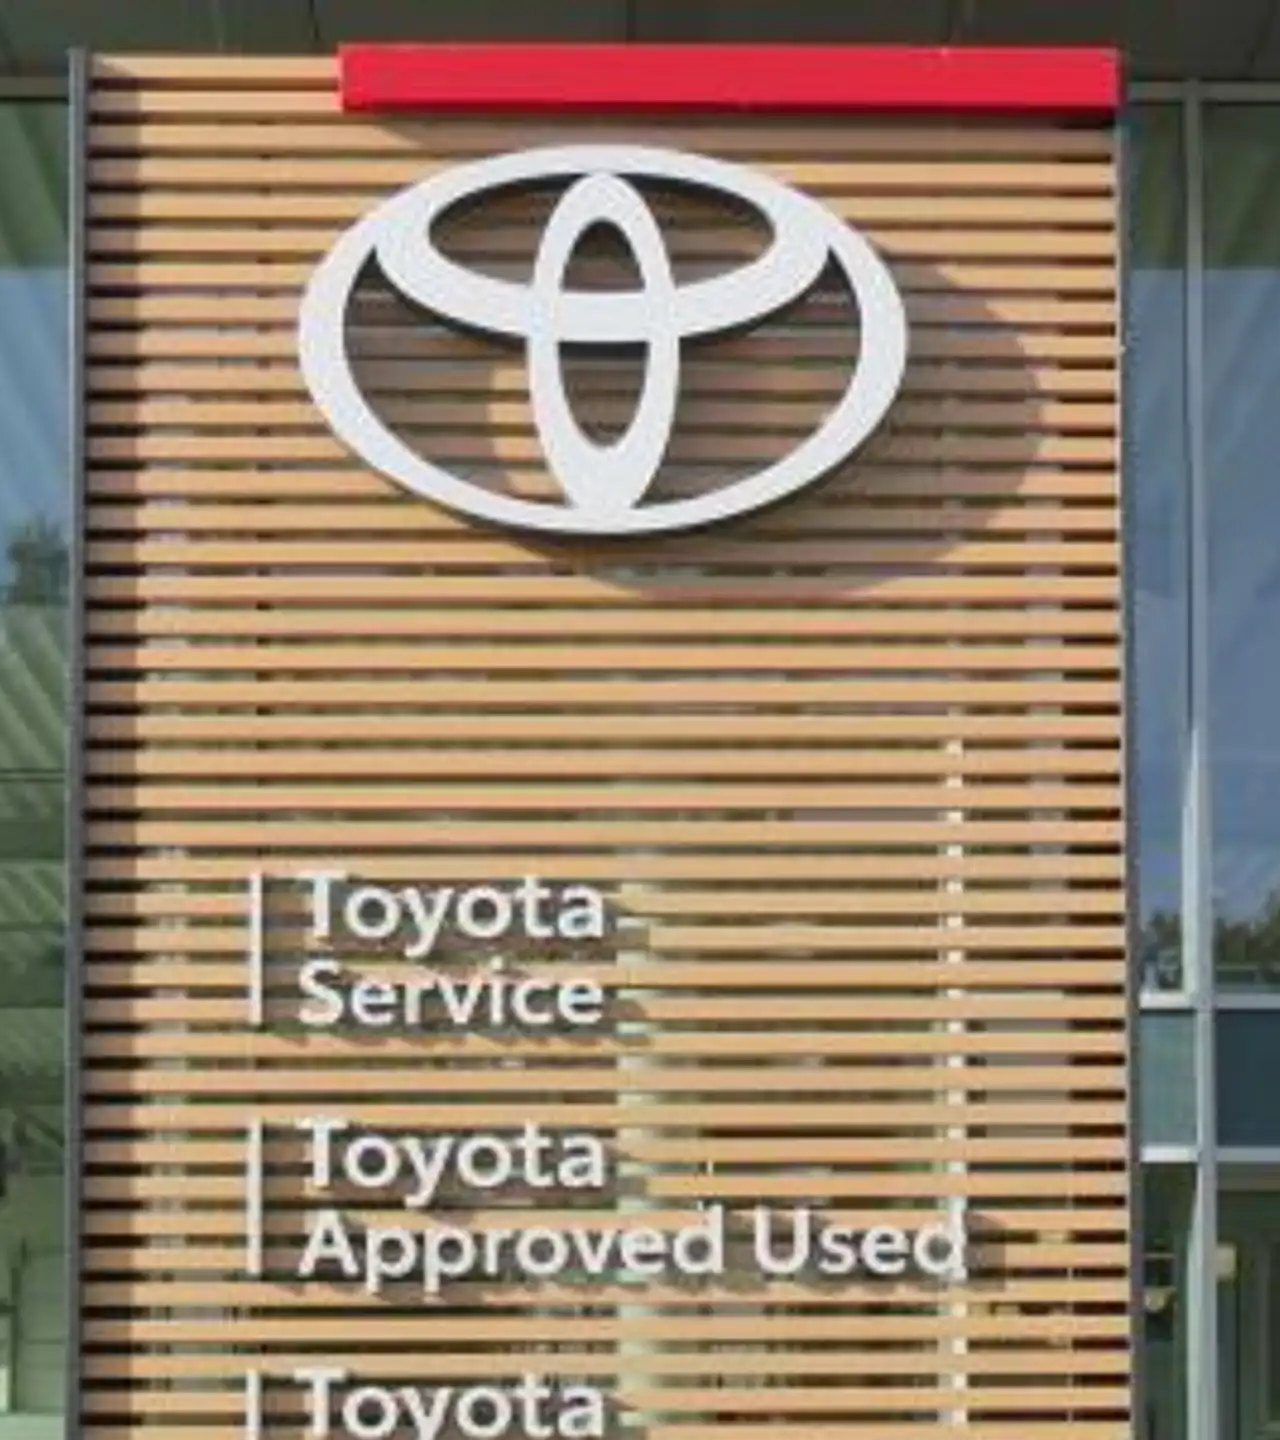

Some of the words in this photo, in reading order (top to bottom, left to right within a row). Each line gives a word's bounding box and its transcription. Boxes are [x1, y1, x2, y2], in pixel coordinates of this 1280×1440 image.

[296, 869, 606, 957] Toyota
[297, 957, 606, 1028] Service
[296, 1117, 606, 1208] Toyota
[297, 1205, 724, 1294] Approved
[753, 1205, 968, 1277] Used
